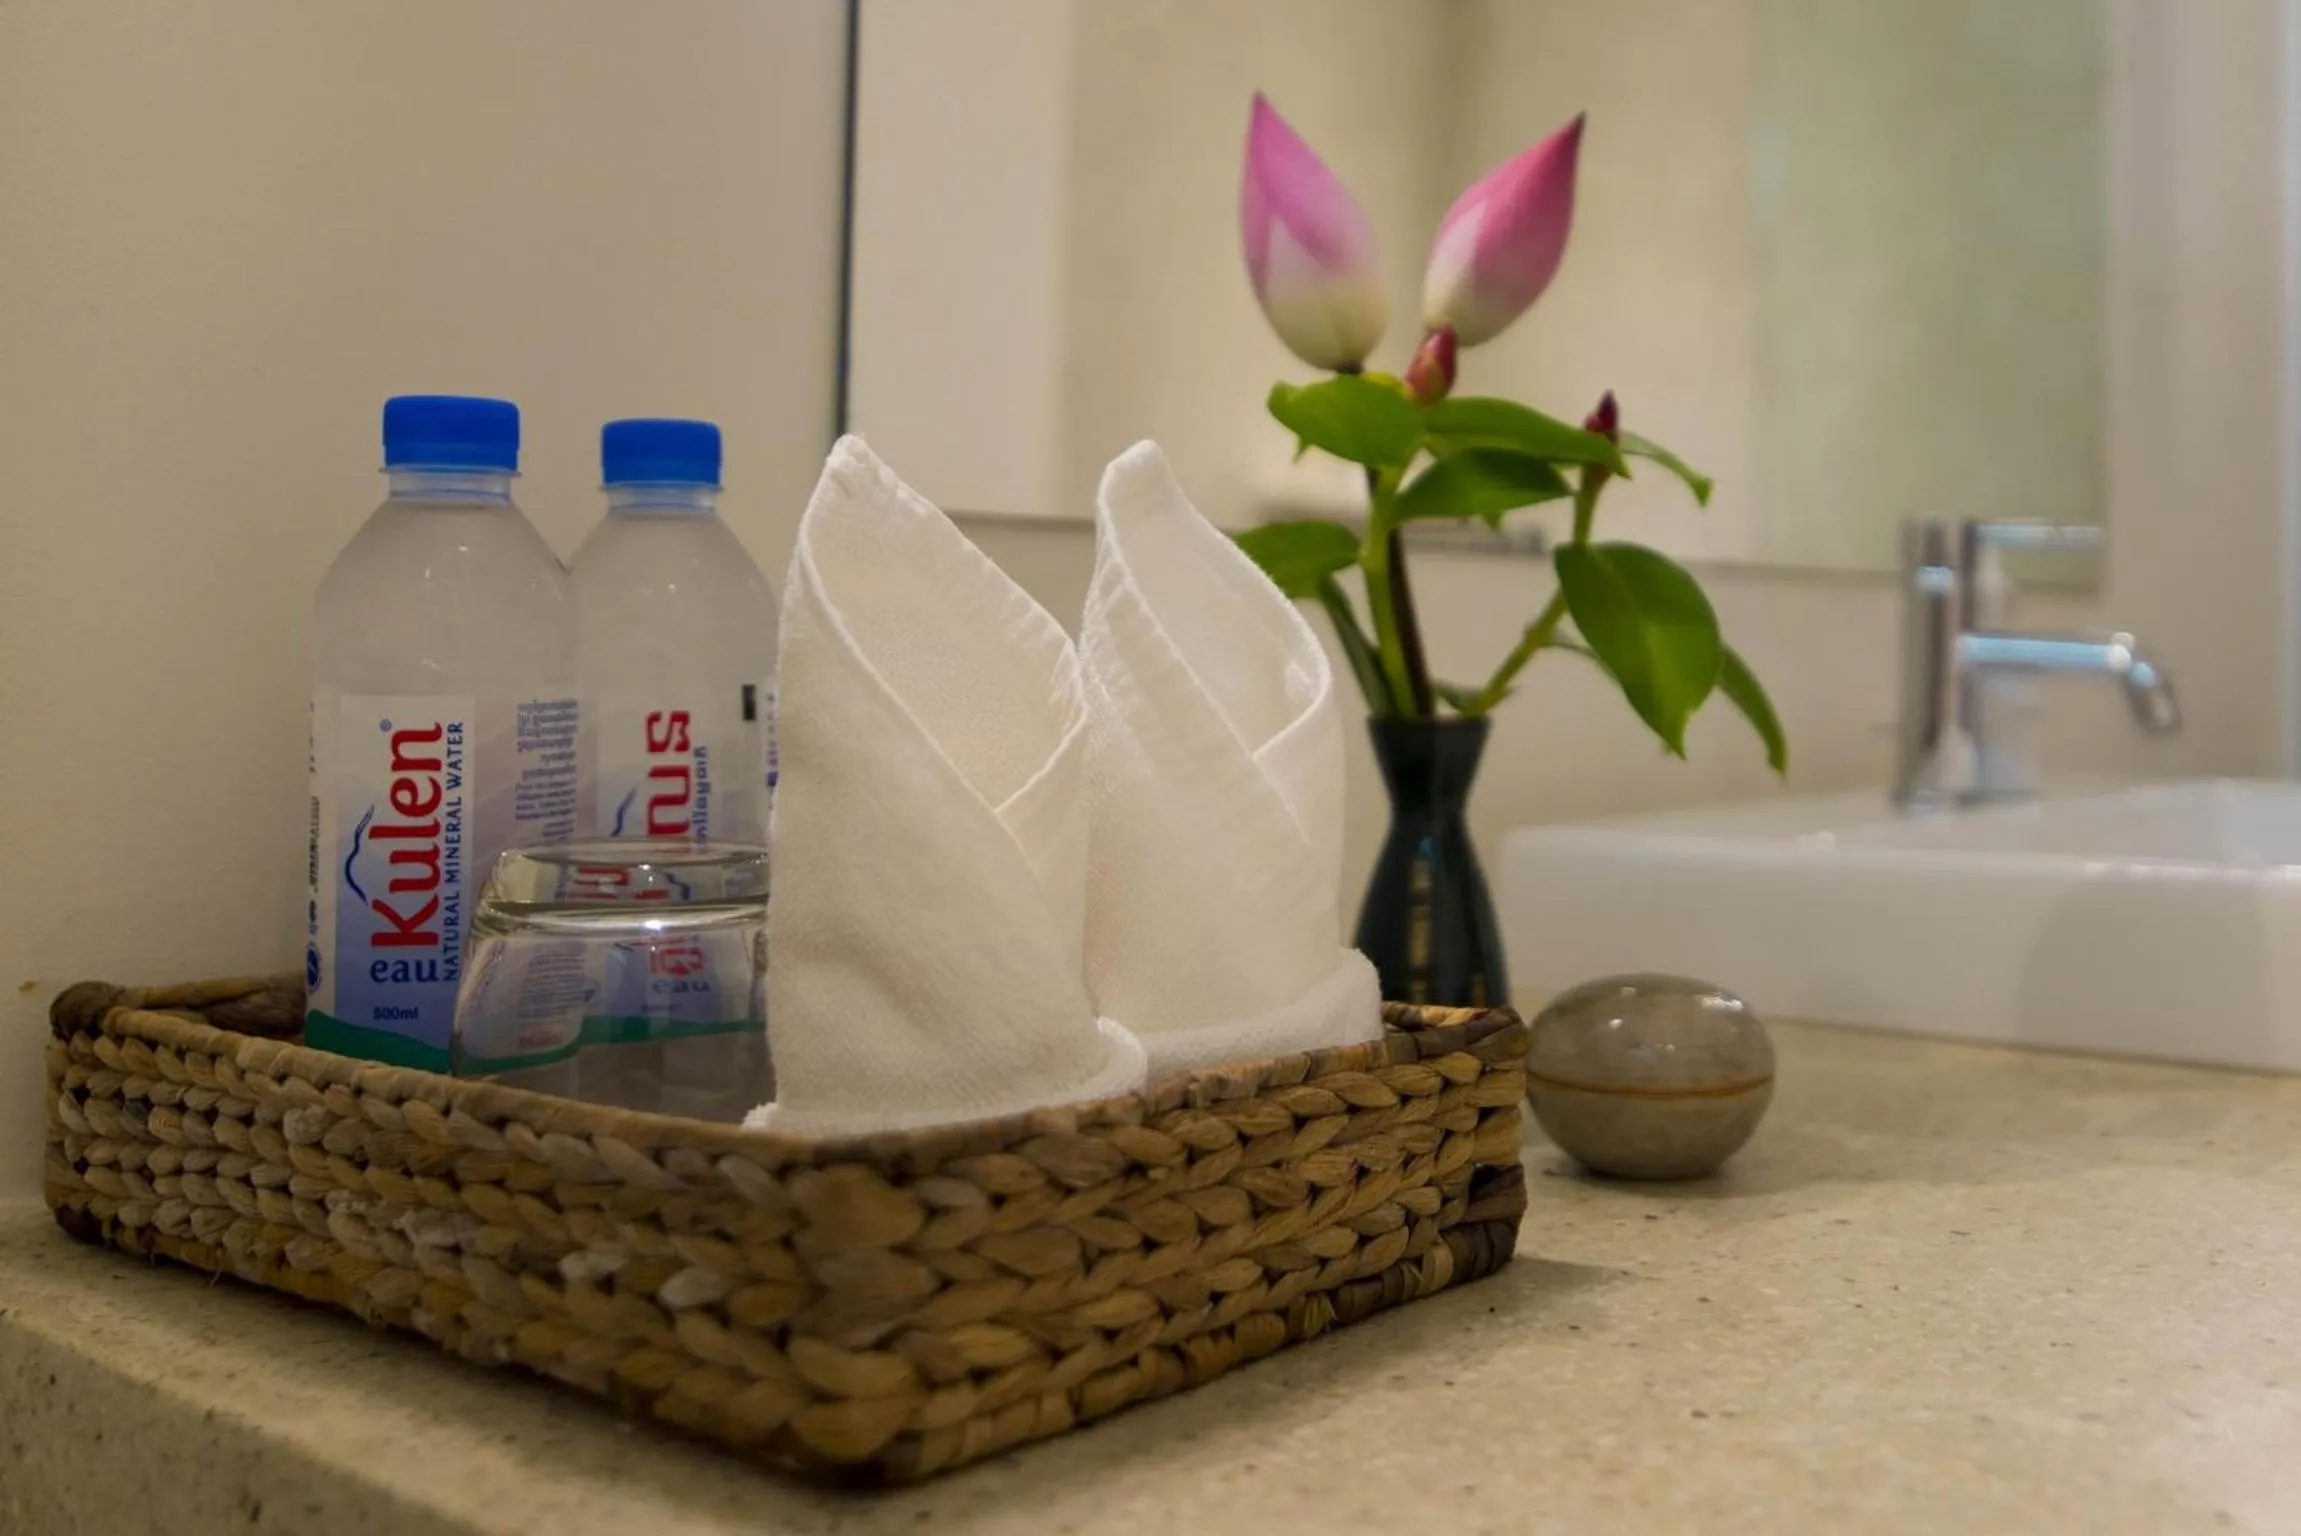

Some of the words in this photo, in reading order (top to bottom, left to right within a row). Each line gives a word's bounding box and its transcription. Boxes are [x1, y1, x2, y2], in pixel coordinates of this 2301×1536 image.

[446, 721, 463, 790] WATER
[368, 722, 442, 947] Kulen
[444, 796, 462, 884] MINERAL
[369, 959, 440, 983] eau
[443, 892, 461, 982] NATURAL
[373, 1005, 419, 1020] 500ml
